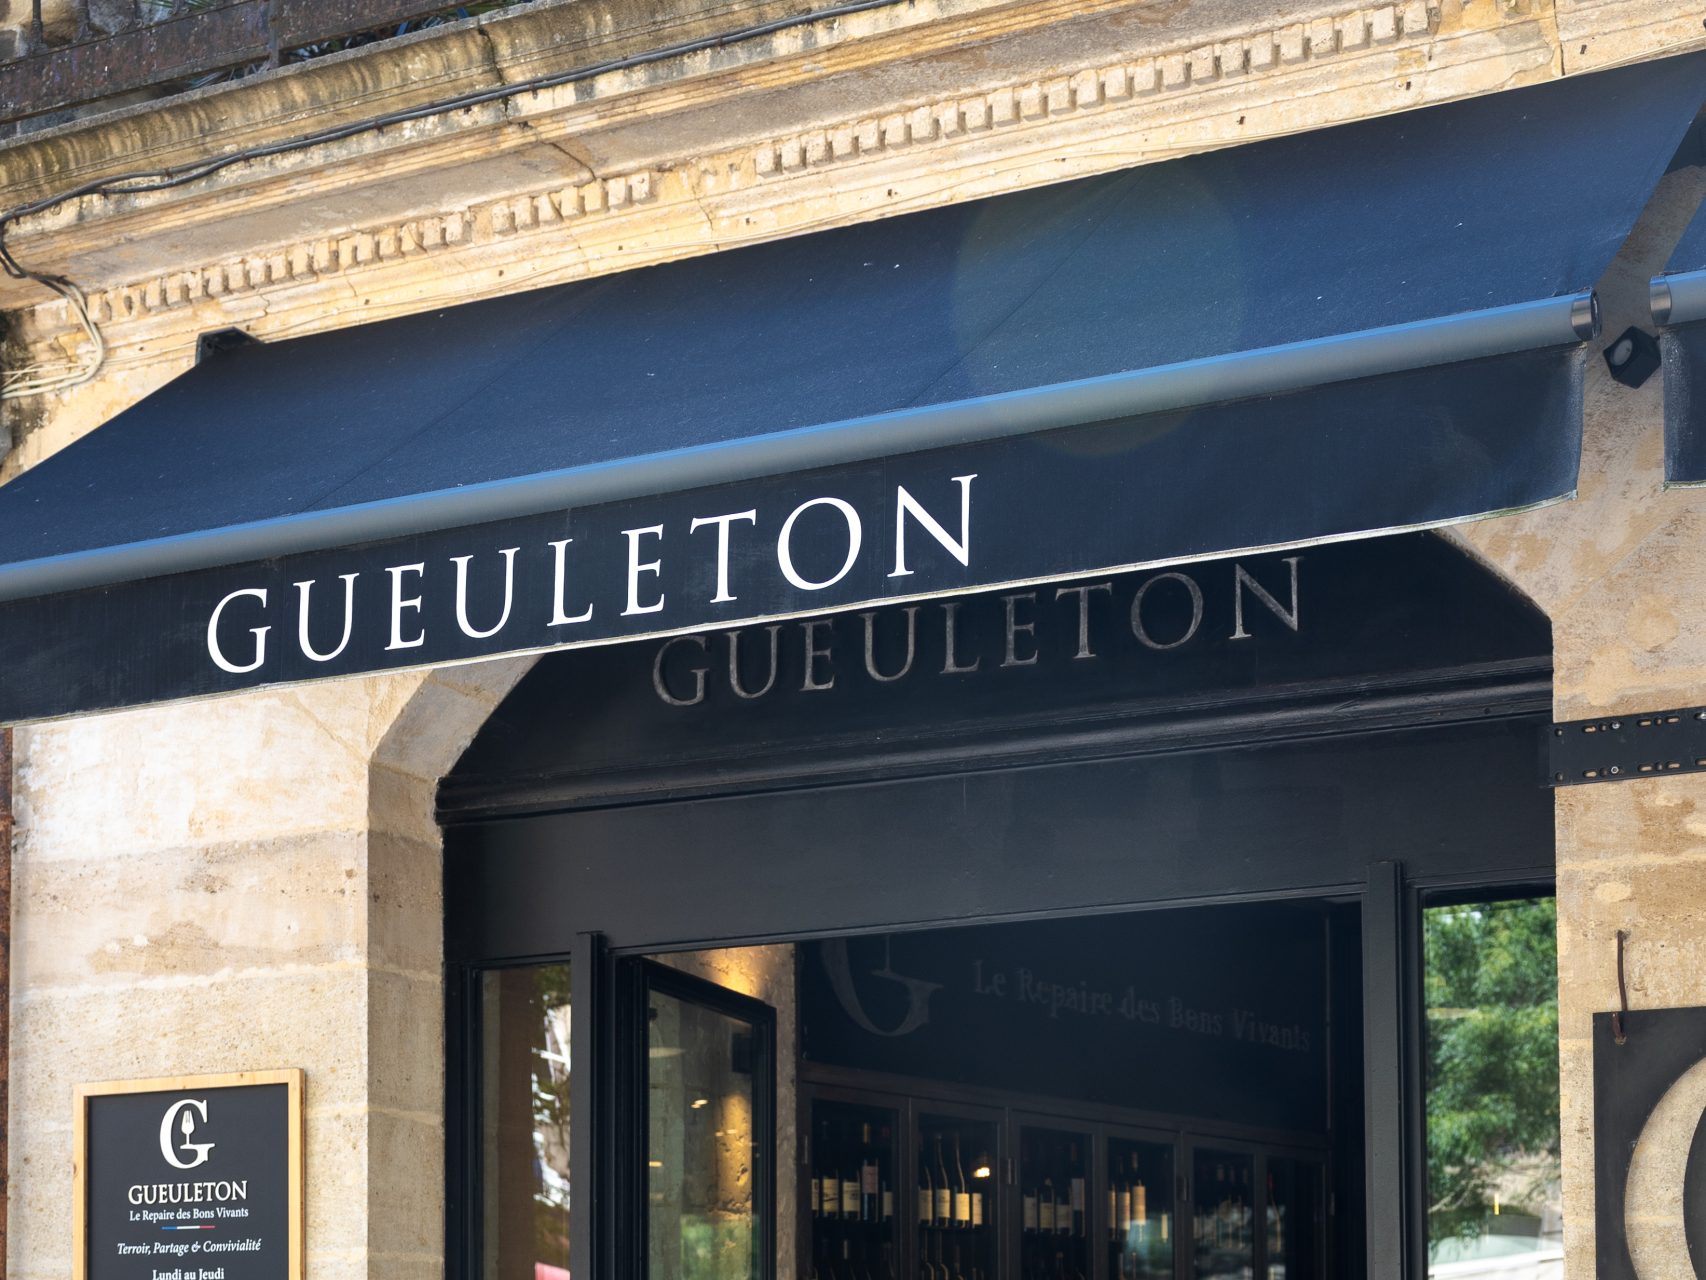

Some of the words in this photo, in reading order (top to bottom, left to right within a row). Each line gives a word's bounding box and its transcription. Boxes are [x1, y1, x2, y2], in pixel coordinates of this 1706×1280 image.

[207, 474, 978, 674] GUEULETON
[652, 557, 1303, 706] GUEULETON
[973, 959, 1006, 997] Le
[1016, 966, 1112, 1019] Repaire
[1117, 984, 1160, 1026] des
[1169, 995, 1223, 1037] Bons
[1231, 1007, 1312, 1053] Vivants
[128, 1180, 247, 1205] GUEULETON
[130, 1210, 140, 1221] Le
[142, 1210, 175, 1223] Repaire
[176, 1208, 191, 1219] des
[193, 1208, 214, 1219] Bons
[216, 1207, 248, 1218] Vivants
[117, 1243, 151, 1255] Terroir,
[153, 1242, 189, 1256] Partage
[191, 1241, 201, 1252] &
[203, 1238, 262, 1252] Convivialité
[152, 1268, 182, 1280] Lundi
[184, 1272, 196, 1280] au
